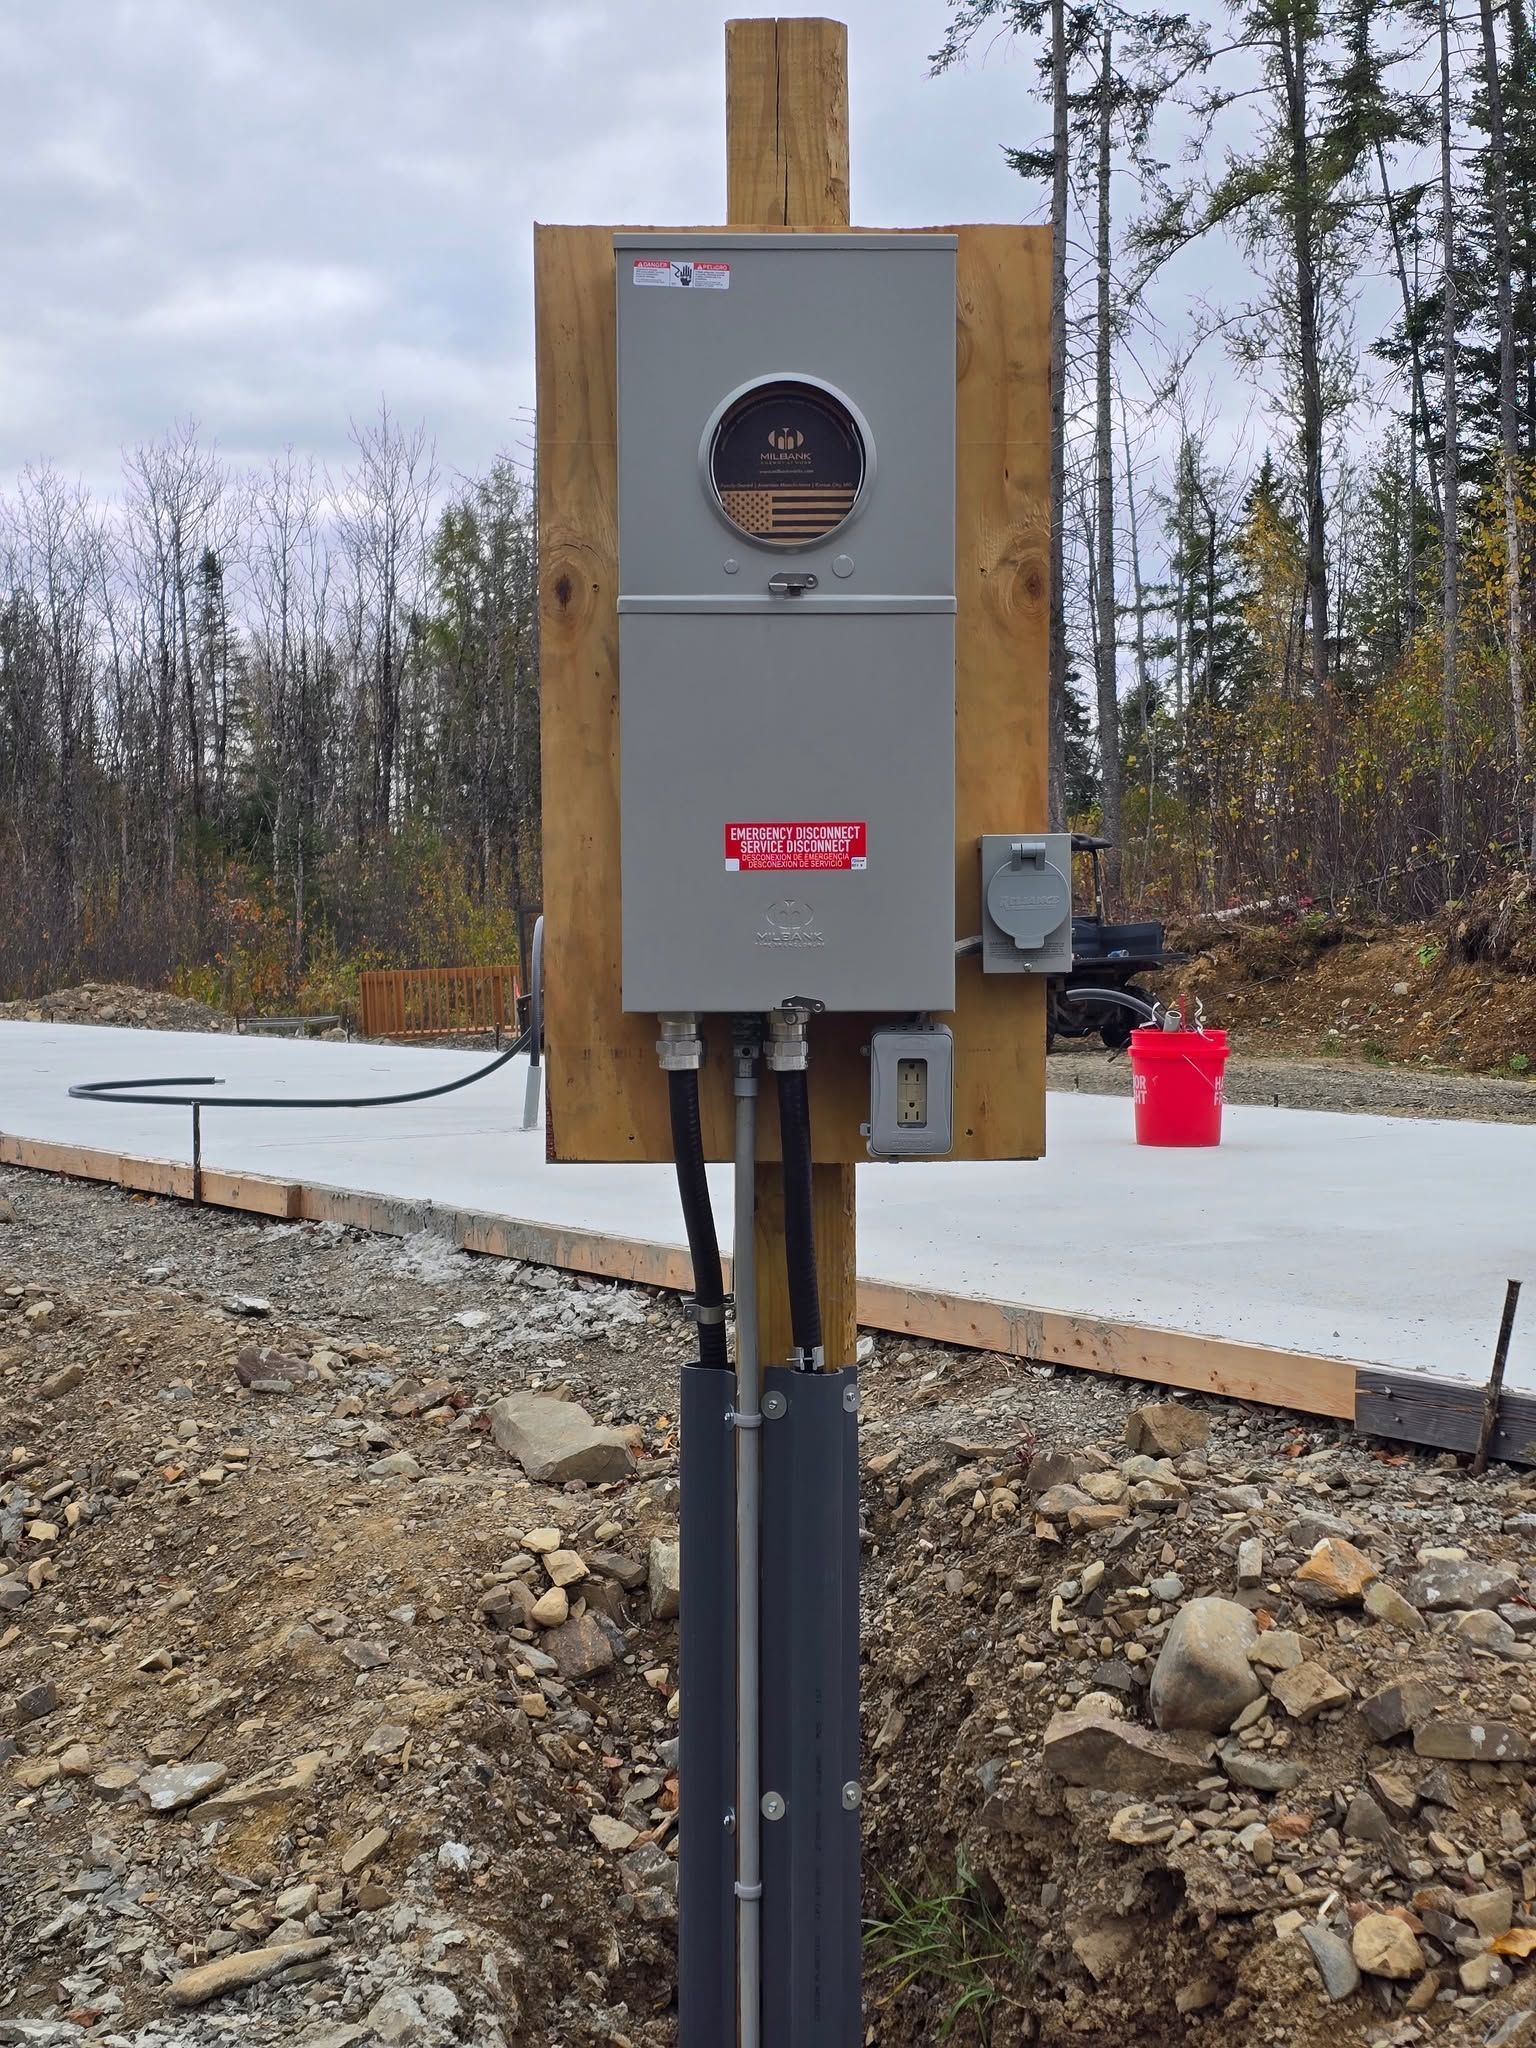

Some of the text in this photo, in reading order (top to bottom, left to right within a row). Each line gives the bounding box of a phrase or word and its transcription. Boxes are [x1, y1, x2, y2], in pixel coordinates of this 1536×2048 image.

[760, 452, 812, 460] MILBANK
[730, 826, 861, 841] EMERGENCY DISCONNECT
[740, 839, 851, 854] SERVICE DISCONNECT
[742, 852, 850, 862] DESCONEXION DE EMERGENCIA
[748, 860, 798, 868] DESCONEXION
[799, 860, 810, 868] DE
[810, 860, 843, 868] SERVICIO
